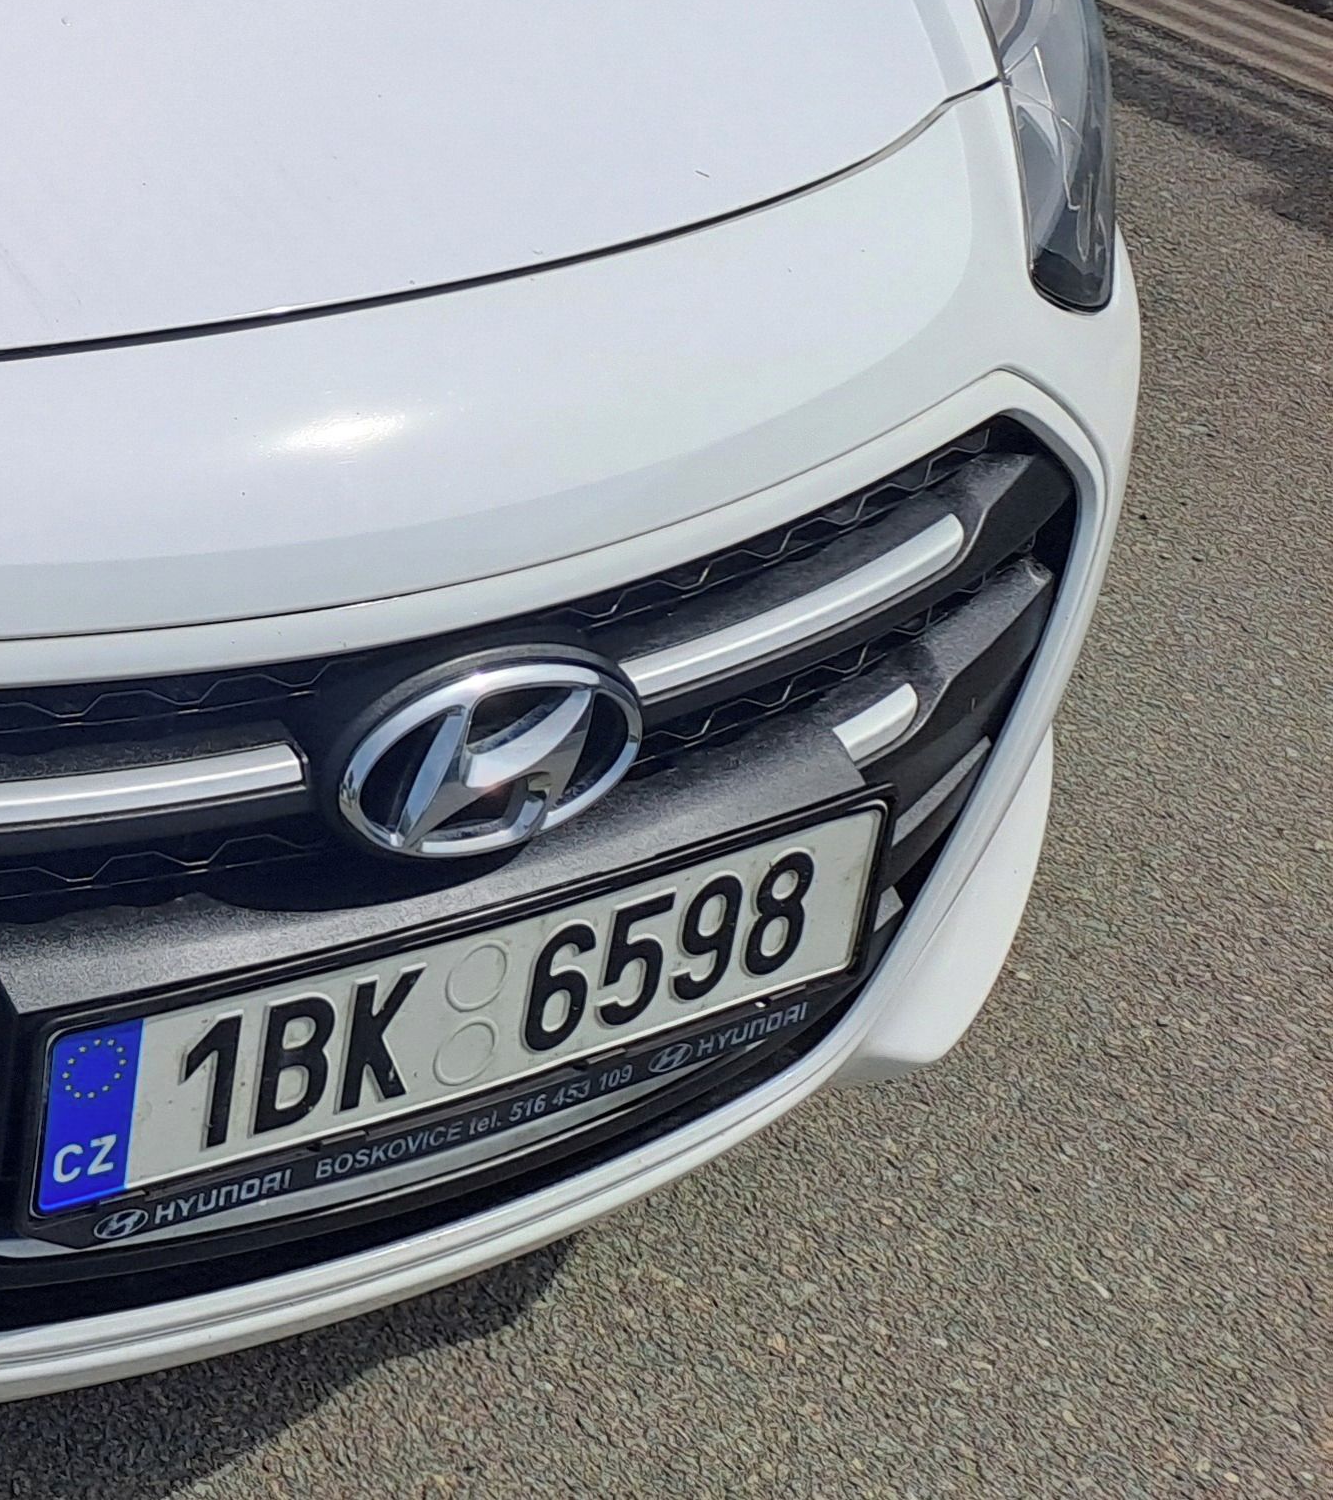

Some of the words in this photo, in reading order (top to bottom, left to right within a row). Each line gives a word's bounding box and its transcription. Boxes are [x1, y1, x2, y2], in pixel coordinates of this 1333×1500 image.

[153, 1168, 293, 1225] HYUNDAI
[315, 1119, 463, 1181] BOSKOVICE
[468, 1110, 502, 1137] tel.
[508, 1094, 547, 1122] 516
[598, 1064, 632, 1091] 109
[696, 1001, 807, 1058] HYUNDAI
[182, 967, 425, 1150] 1BK
[522, 852, 817, 1053] 6598
[52, 1134, 117, 1183] CZ
